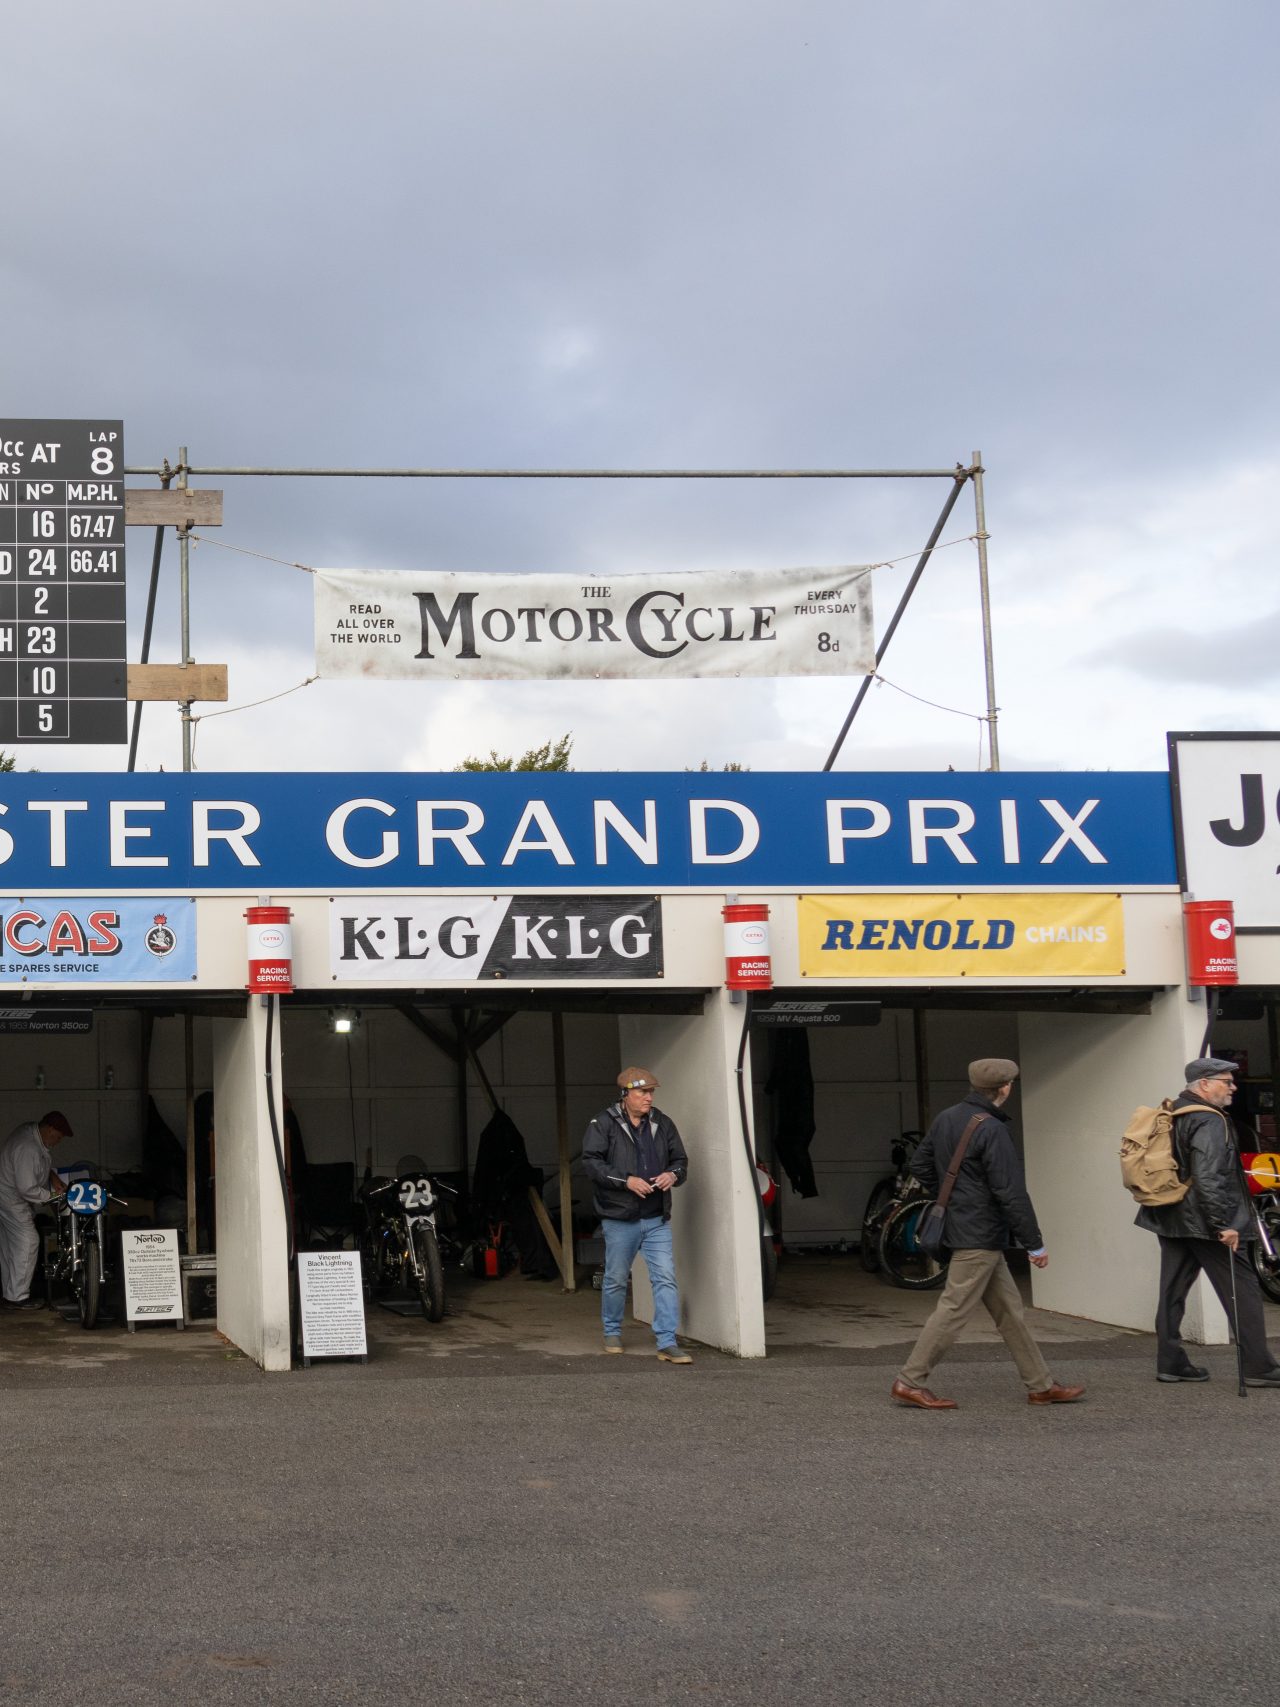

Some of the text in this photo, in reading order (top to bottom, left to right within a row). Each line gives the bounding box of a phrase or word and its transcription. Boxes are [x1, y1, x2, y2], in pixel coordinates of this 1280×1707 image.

[89, 432, 118, 443] LAP
[31, 443, 61, 463] AT
[90, 447, 114, 475] 8
[68, 484, 118, 501] M.P.H.
[32, 511, 55, 537] 16
[70, 515, 115, 538] 67.47
[28, 549, 57, 576] 24
[70, 550, 117, 573] 66.41
[34, 587, 48, 614] 2
[581, 586, 612, 598] THE
[807, 590, 843, 601] EVERY
[349, 604, 382, 614] READ
[793, 603, 857, 615] THURSDAY
[336, 618, 395, 629] ALL OVER
[27, 626, 56, 654] 23
[330, 633, 402, 644] THE WORLD
[817, 631, 840, 653] 8d
[33, 667, 56, 694] 10
[38, 705, 53, 732] 5
[1209, 773, 1280, 847] J
[325, 798, 761, 868] GRAND
[825, 799, 1109, 864] PRIX
[821, 919, 1108, 951] RENOLD CHAINS
[9, 964, 51, 973] SPARES
[54, 963, 99, 973] SERVICE
[792, 1015, 822, 1023] Agusta
[71, 1183, 104, 1210] 23
[401, 1179, 432, 1208] 23
[134, 1234, 165, 1244] Norton
